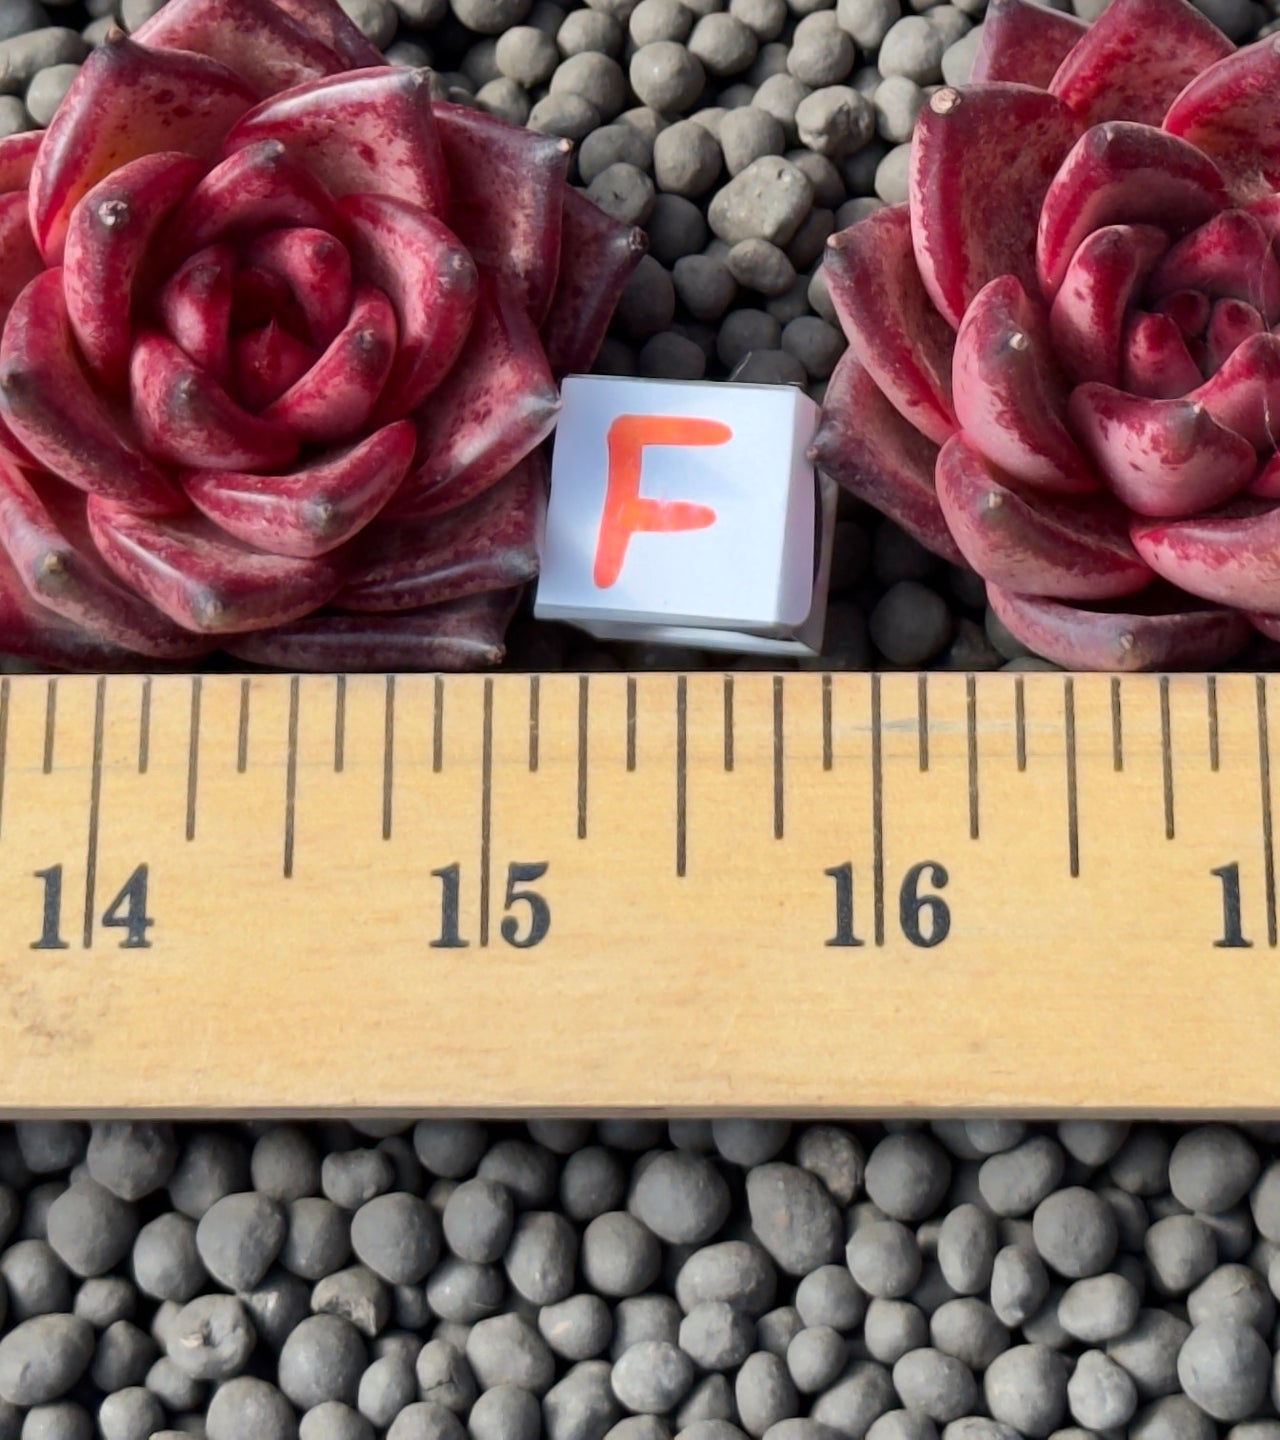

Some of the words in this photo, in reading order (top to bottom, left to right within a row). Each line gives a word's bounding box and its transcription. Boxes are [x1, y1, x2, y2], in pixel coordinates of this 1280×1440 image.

[593, 415, 732, 589] F
[29, 864, 154, 950] 14
[428, 862, 553, 950] 15
[824, 861, 954, 948] 16
